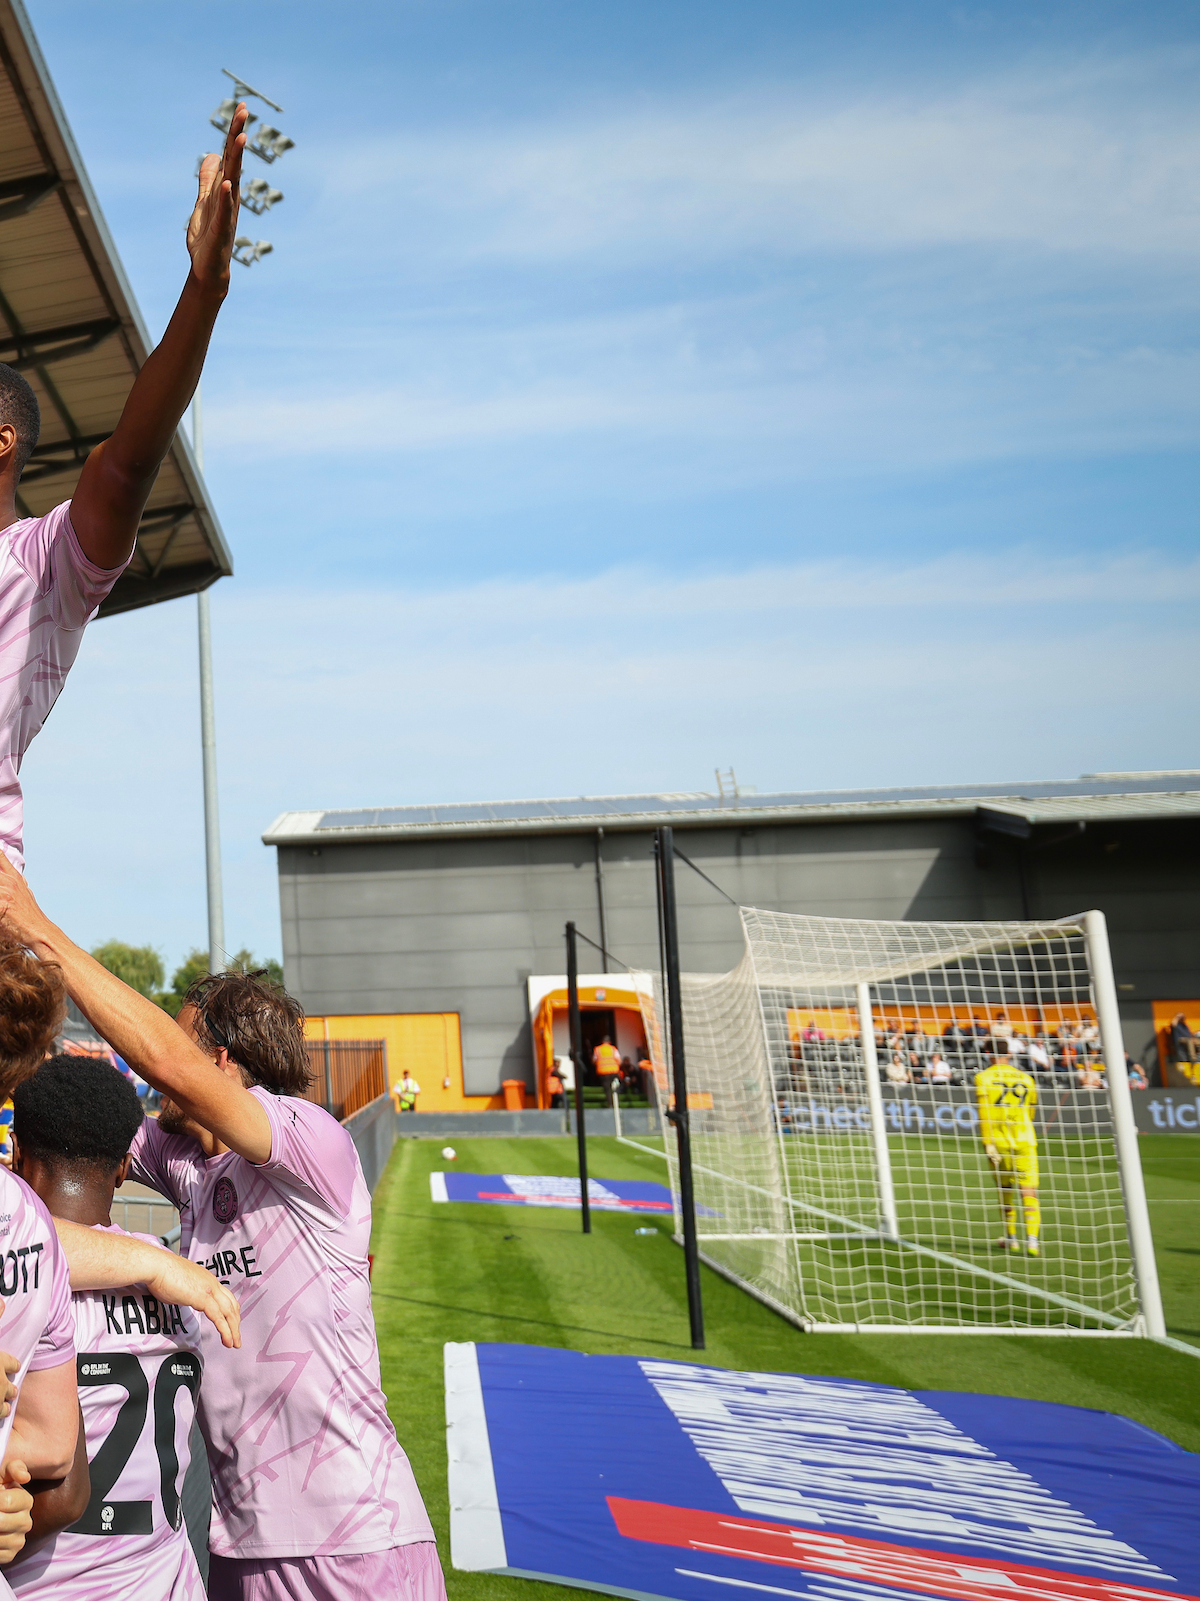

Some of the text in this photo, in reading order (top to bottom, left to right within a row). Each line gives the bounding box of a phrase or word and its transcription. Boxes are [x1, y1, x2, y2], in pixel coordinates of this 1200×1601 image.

[992, 1082, 1028, 1107] 29
[102, 1294, 188, 1335] KABIA
[62, 1352, 202, 1535] 20
